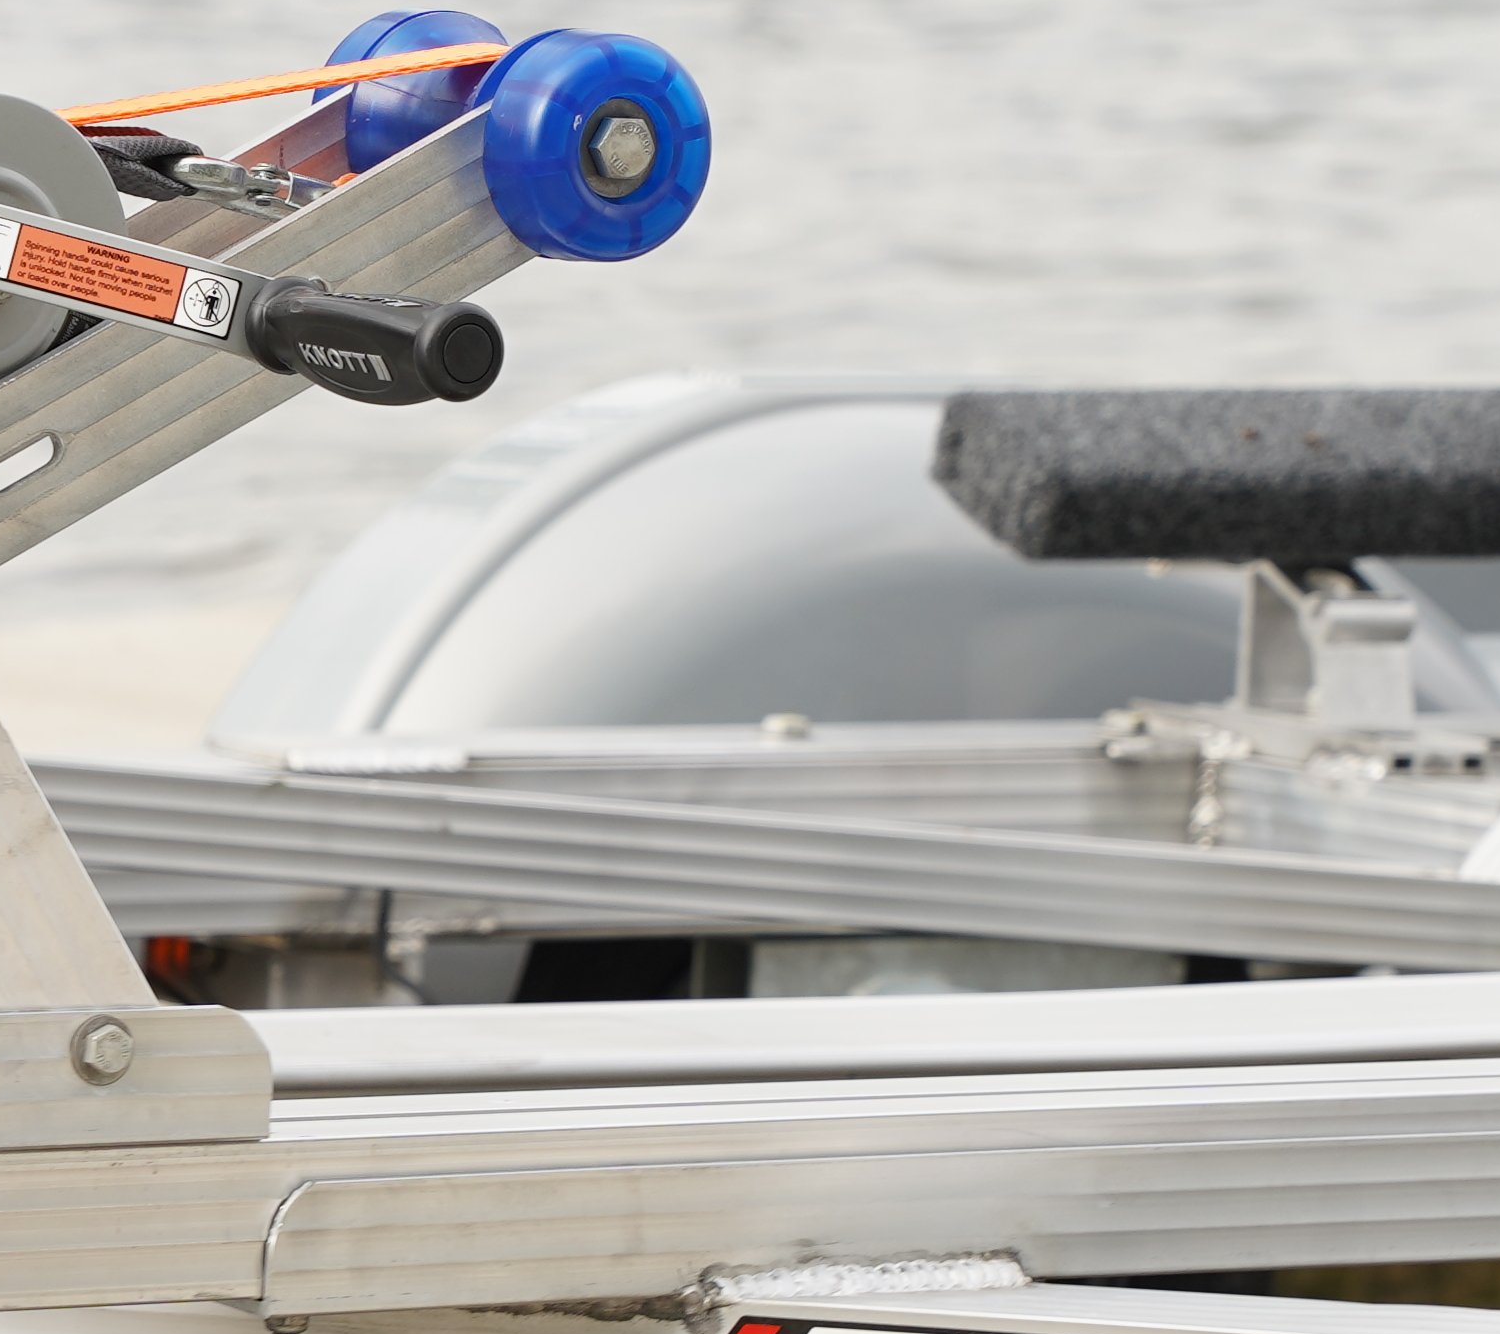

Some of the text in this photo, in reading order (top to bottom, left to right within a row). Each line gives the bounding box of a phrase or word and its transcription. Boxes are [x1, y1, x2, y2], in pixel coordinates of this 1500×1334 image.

[22, 250, 173, 297] injury. Hold handle firmly when ratchet
[24, 239, 170, 285] Spinning handle could cause serious
[87, 245, 130, 264] WARNING
[16, 270, 101, 299] or loads over people.
[20, 259, 157, 303] is unlocked. Not for moving people
[298, 342, 369, 374] KNOTT
